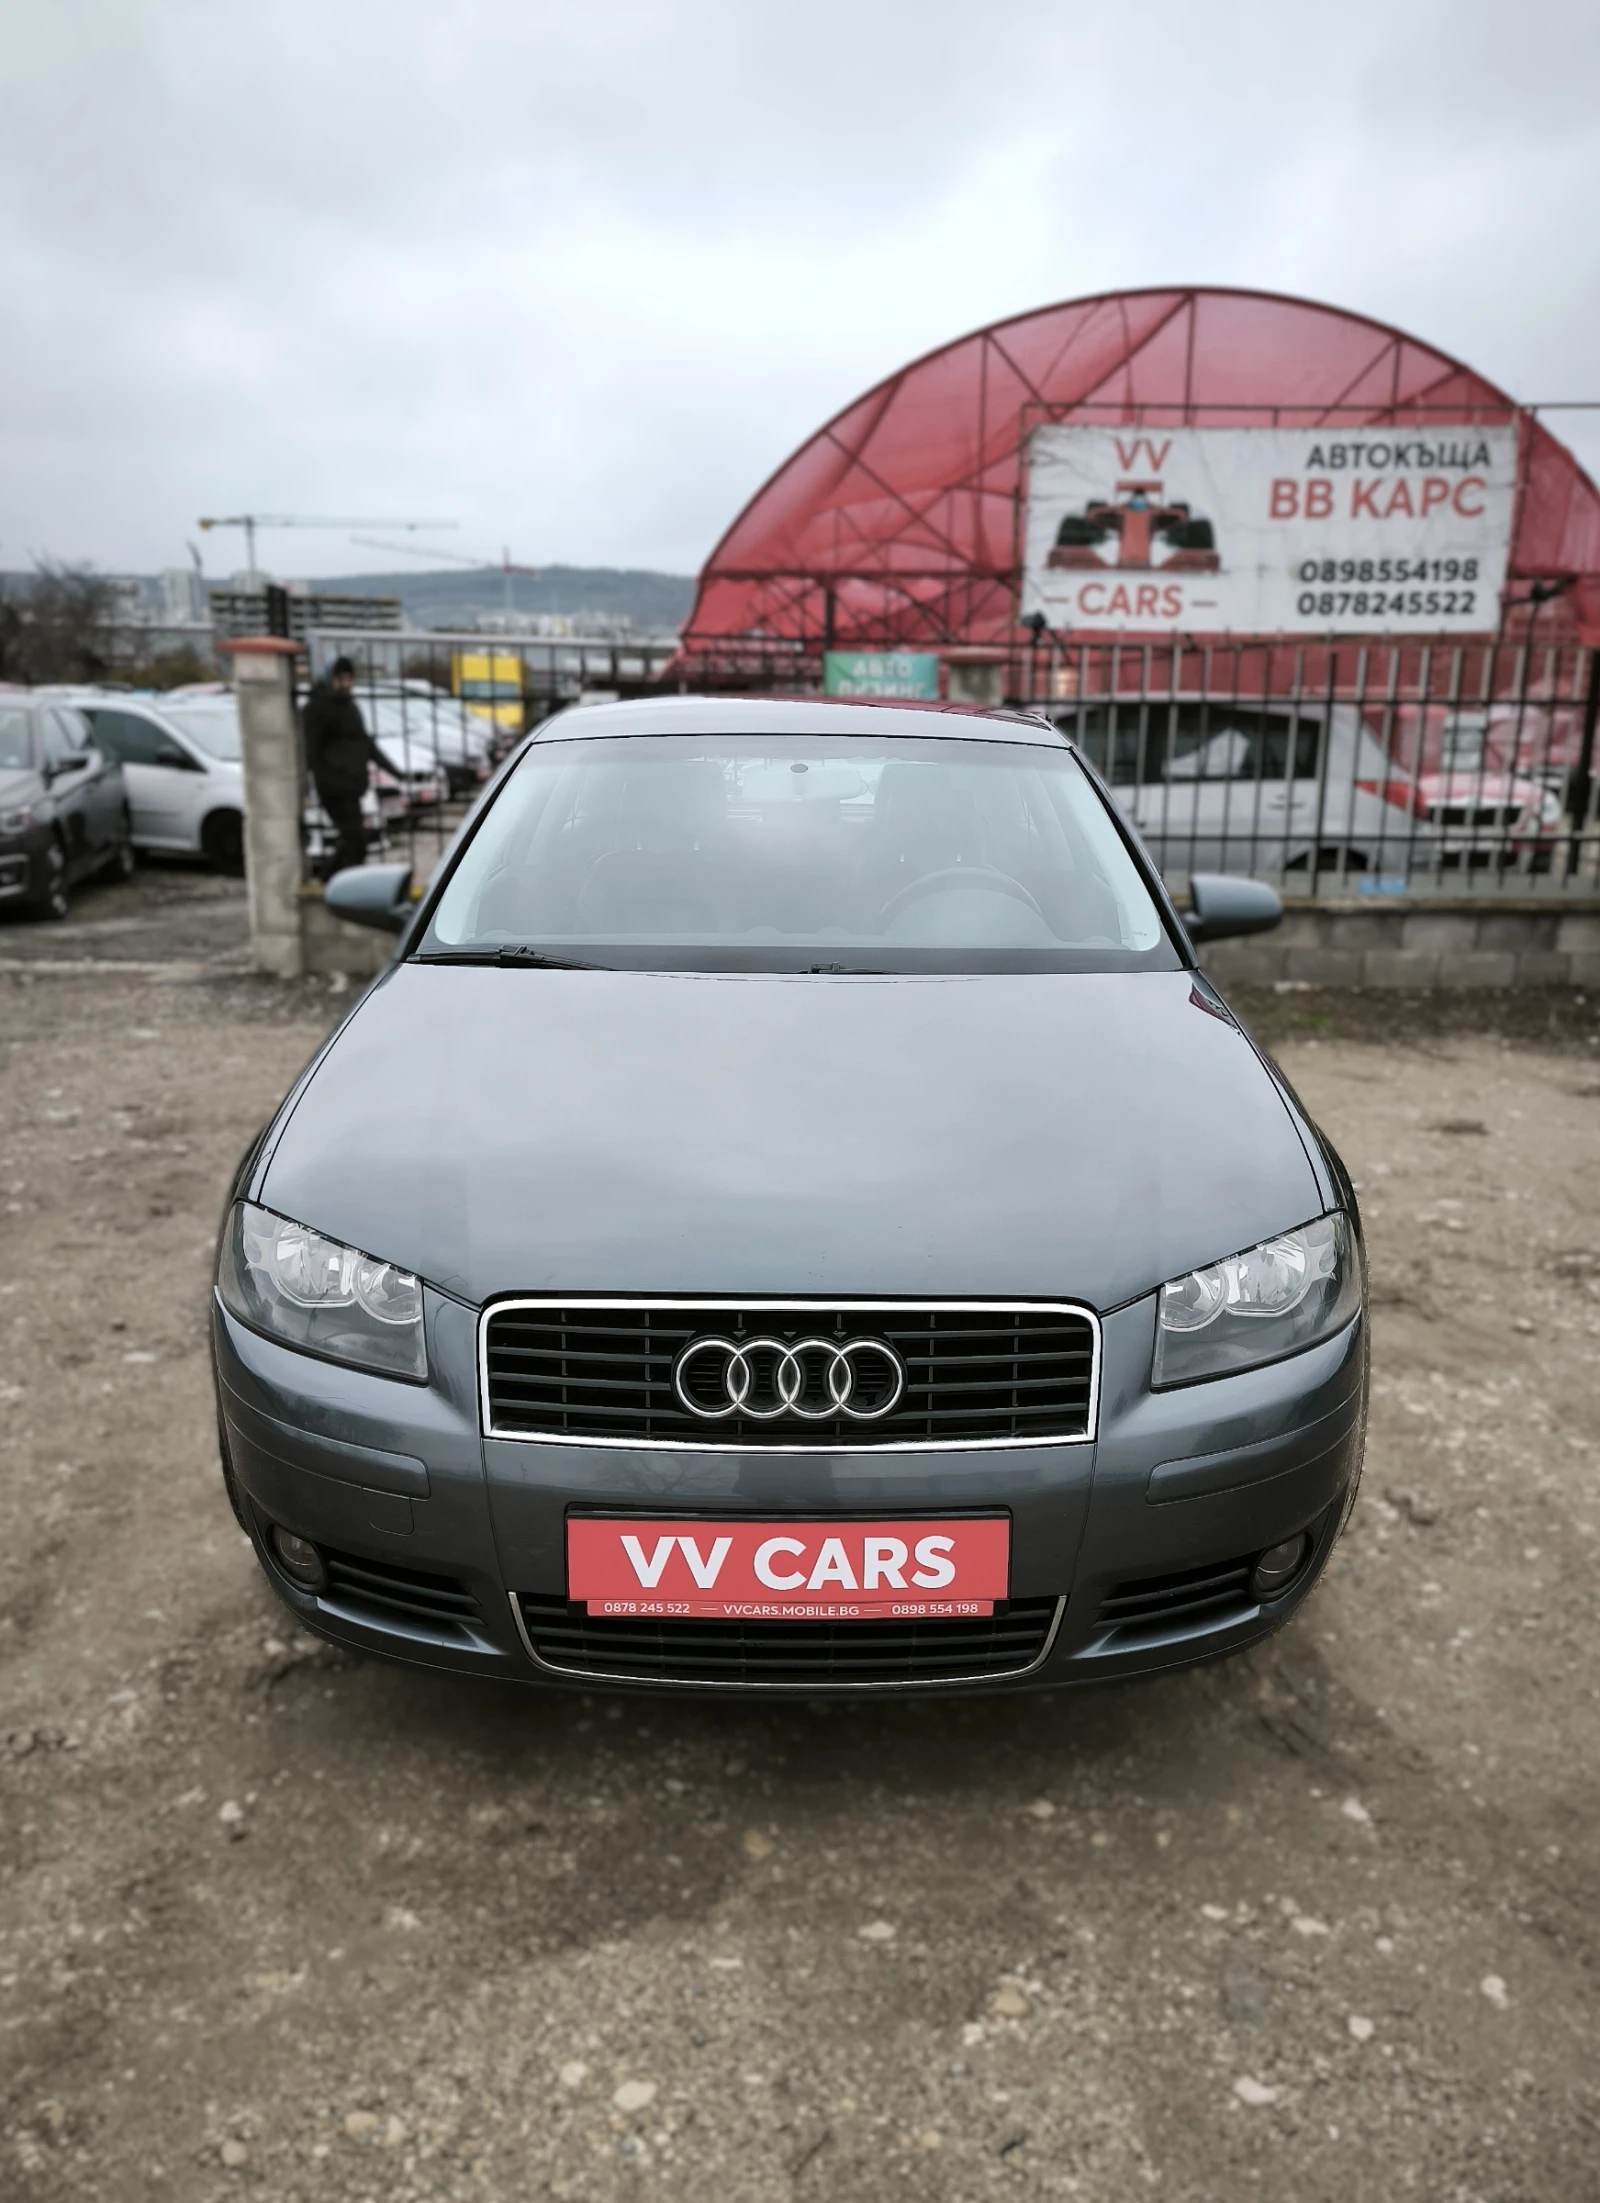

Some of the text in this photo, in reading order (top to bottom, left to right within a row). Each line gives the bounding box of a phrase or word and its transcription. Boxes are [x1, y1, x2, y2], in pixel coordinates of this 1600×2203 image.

[1114, 438, 1172, 471] VV
[1305, 441, 1493, 472] АВТОКЪЩА
[1350, 477, 1489, 518] КАРС
[1300, 558, 1479, 583] 0898554198
[1077, 583, 1183, 618] CARS
[1298, 591, 1476, 616] 0878245522
[619, 1535, 957, 1591] VV CARS
[604, 1602, 691, 1614] 0878 245 522
[723, 1604, 860, 1616] VVCARS.MOBILE.BG
[891, 1602, 979, 1615] 0898 554 198
